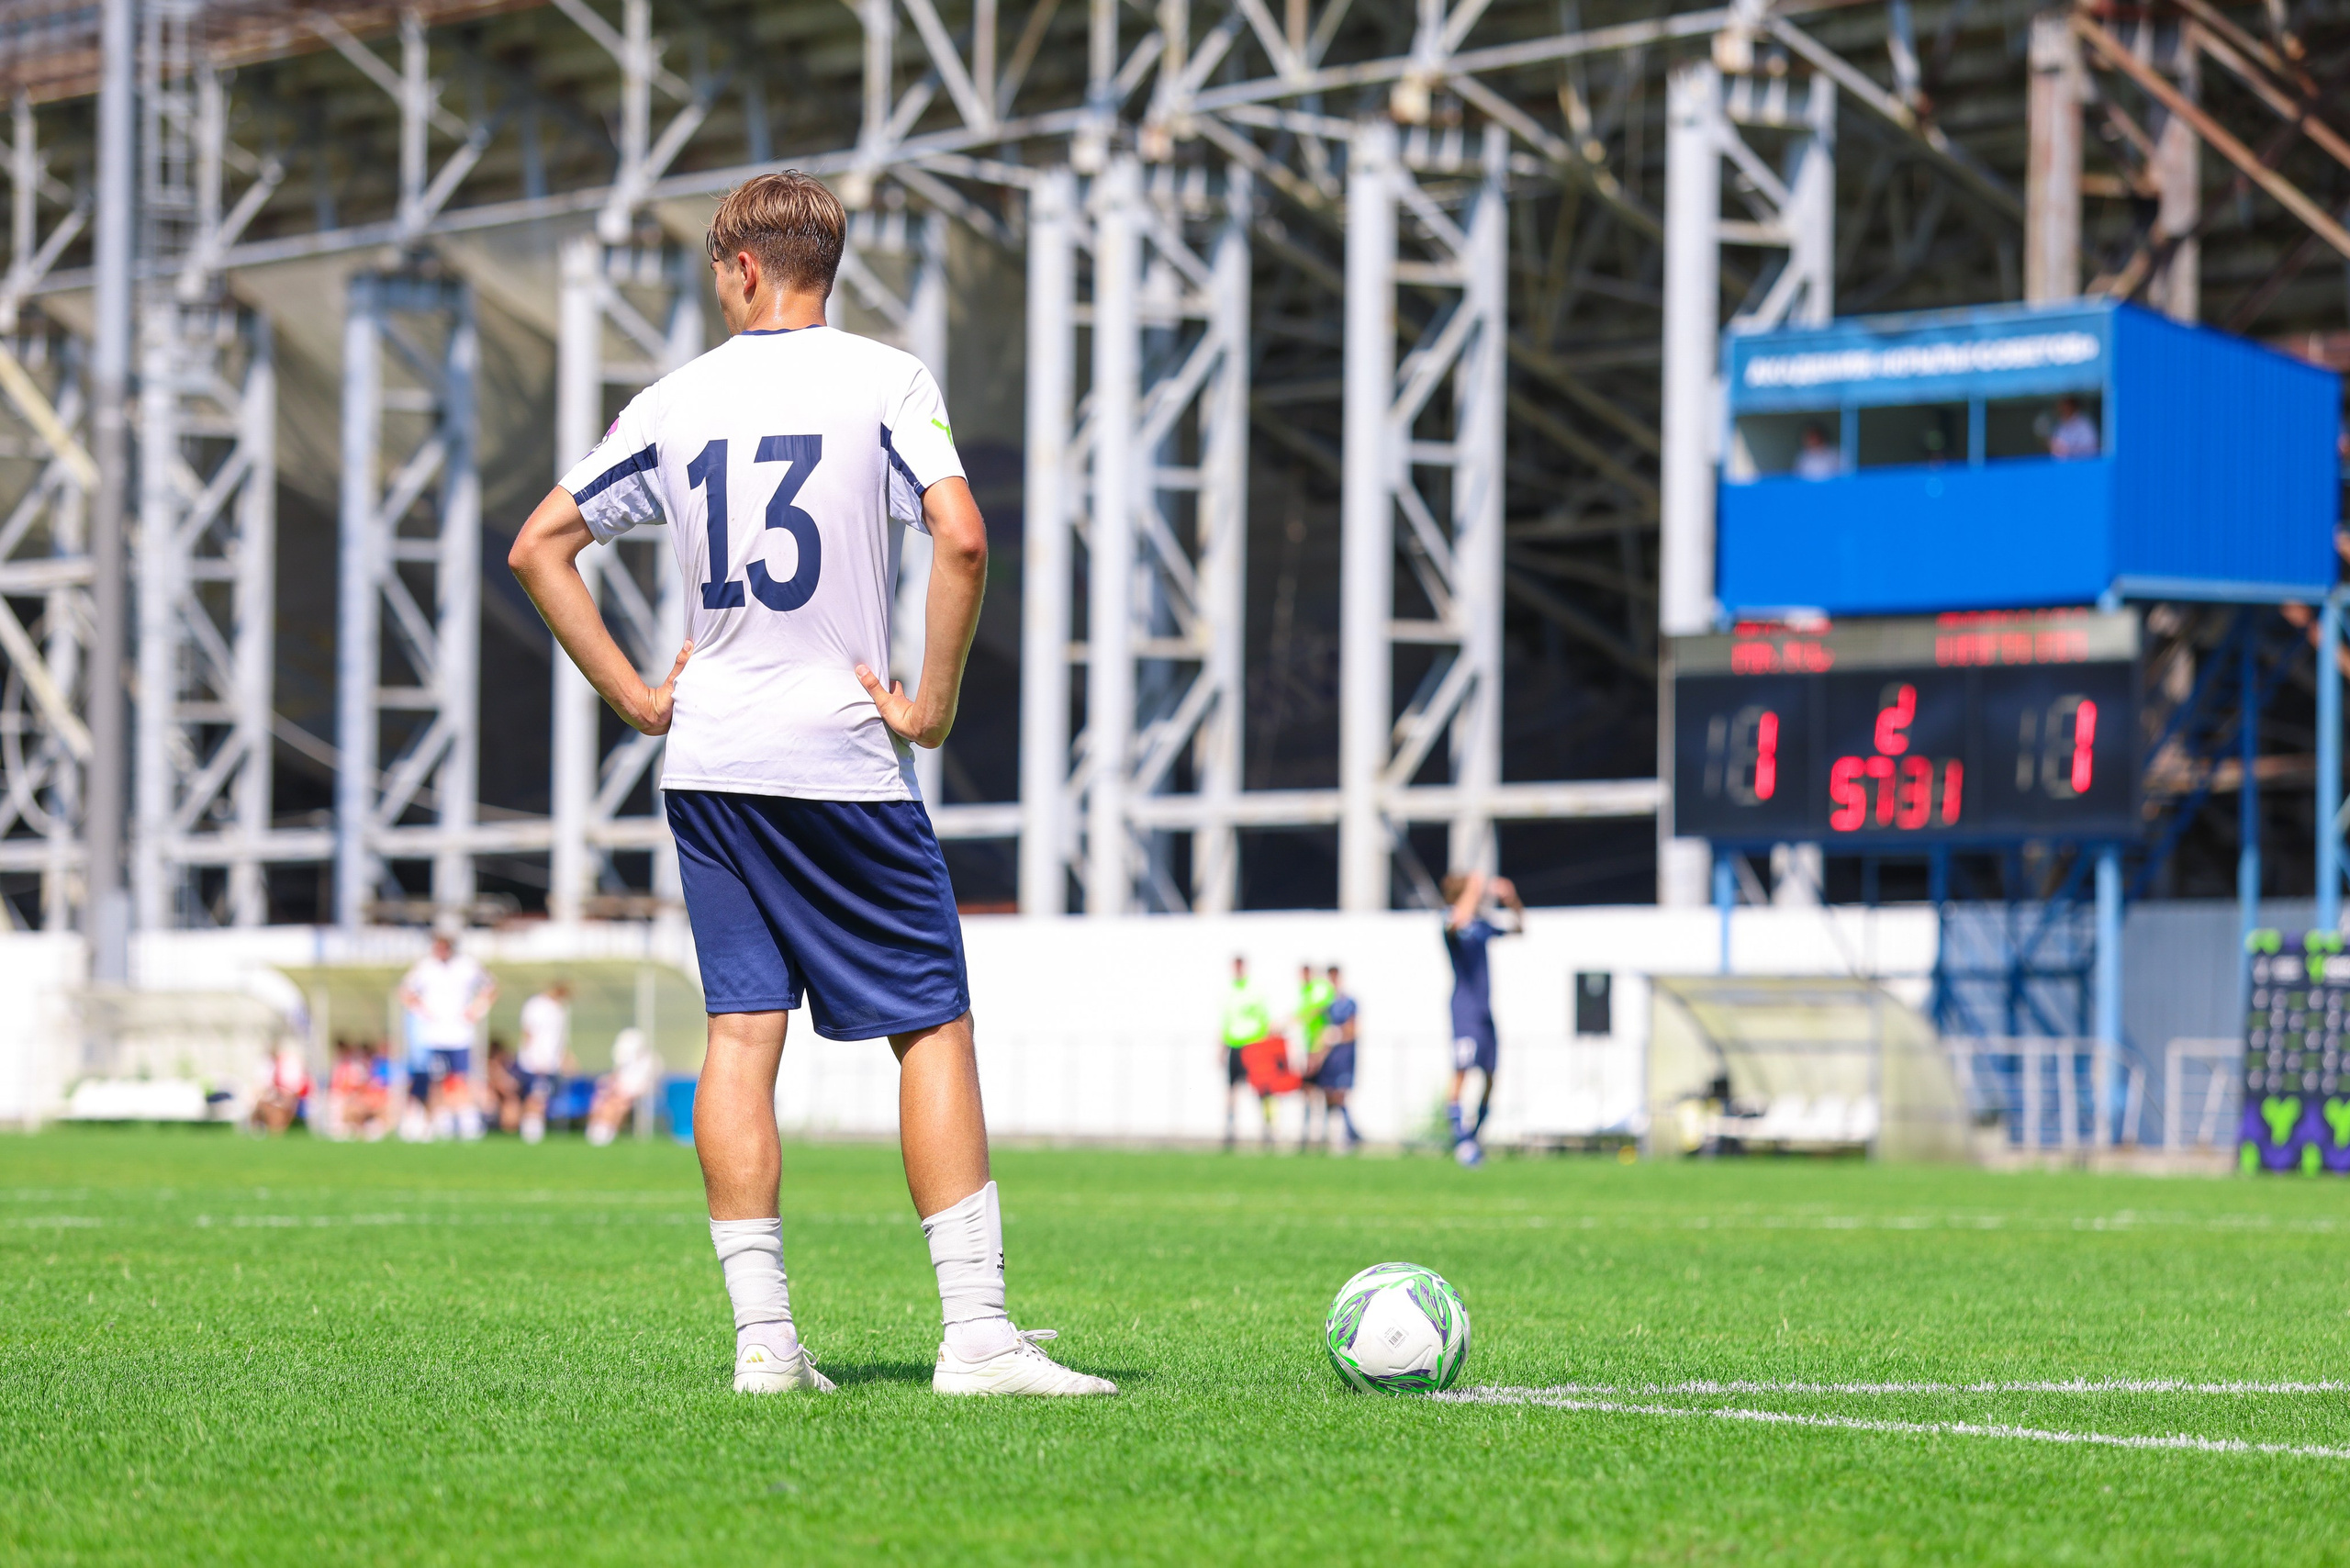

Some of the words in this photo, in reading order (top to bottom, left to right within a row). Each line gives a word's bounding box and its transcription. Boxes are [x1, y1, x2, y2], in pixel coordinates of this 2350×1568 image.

[687, 433, 822, 612] 13
[1754, 711, 1779, 801] 1
[1874, 683, 1917, 756] 2
[2071, 700, 2098, 794] 1
